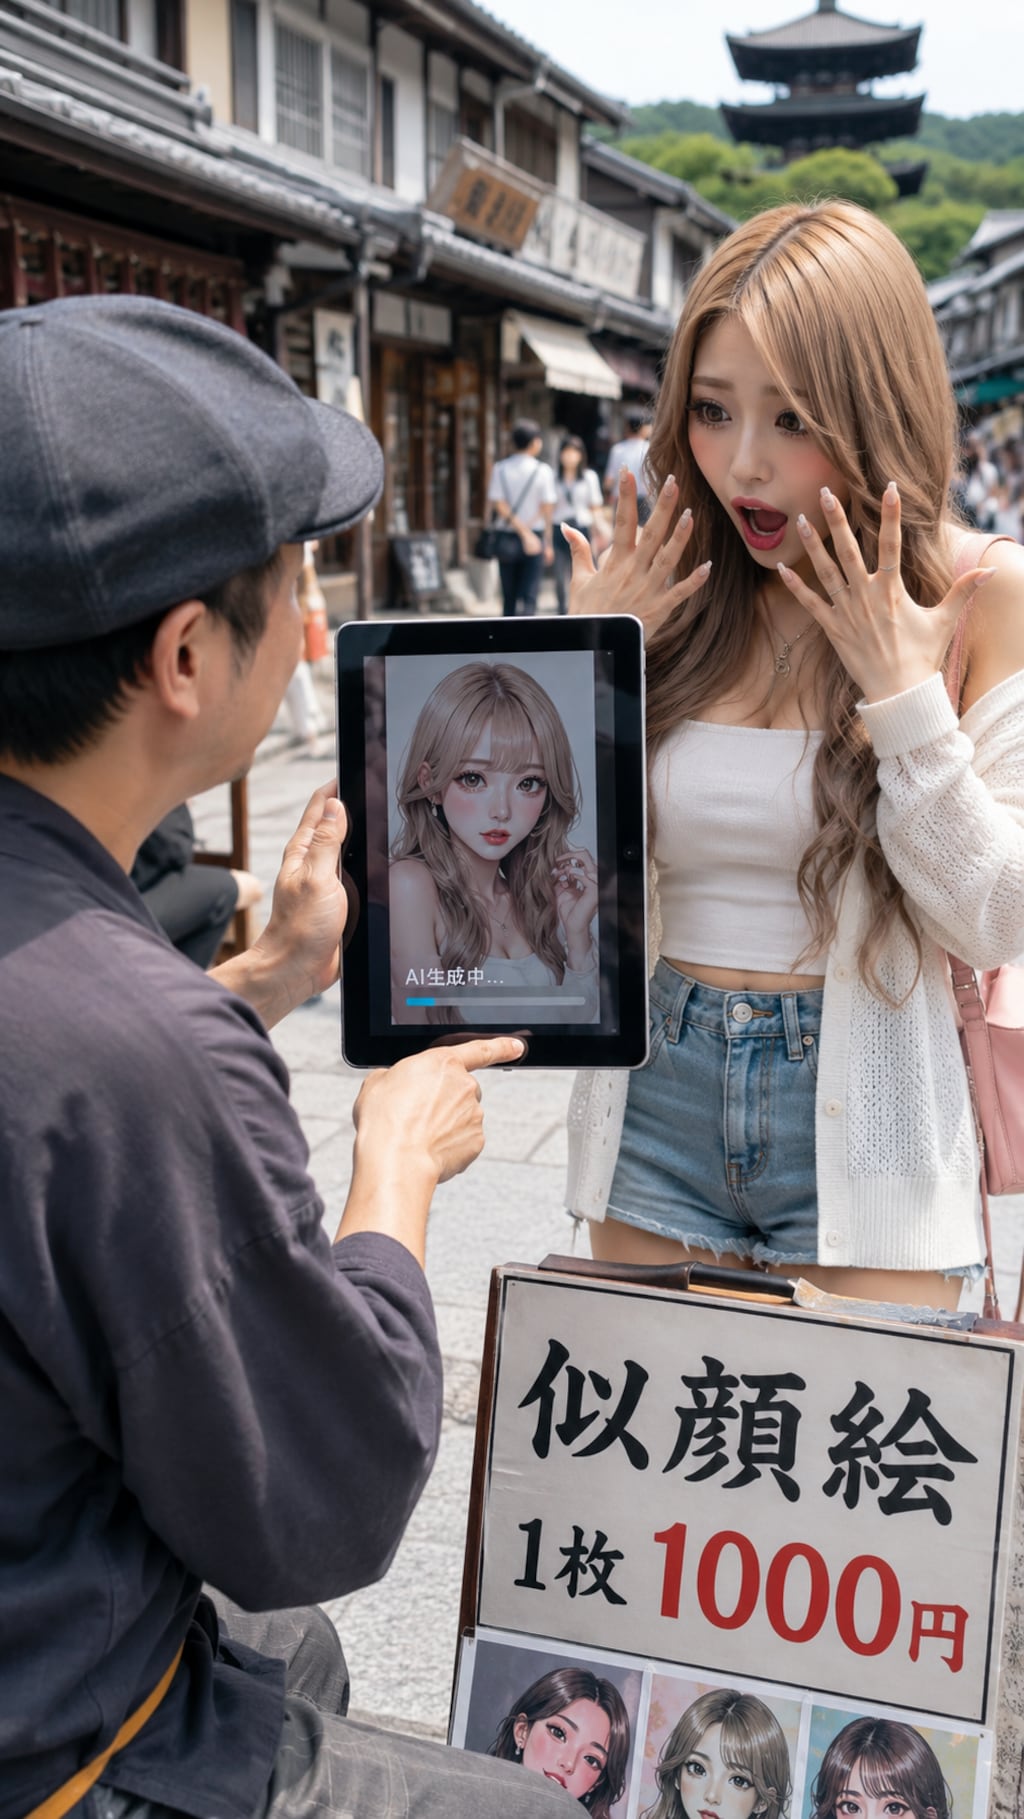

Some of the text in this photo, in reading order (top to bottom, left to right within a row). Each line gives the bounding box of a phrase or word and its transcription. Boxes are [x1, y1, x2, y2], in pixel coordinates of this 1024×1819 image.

[517, 1338, 979, 1526] 似顔絵
[513, 1517, 970, 1673] 1枚 1000円
